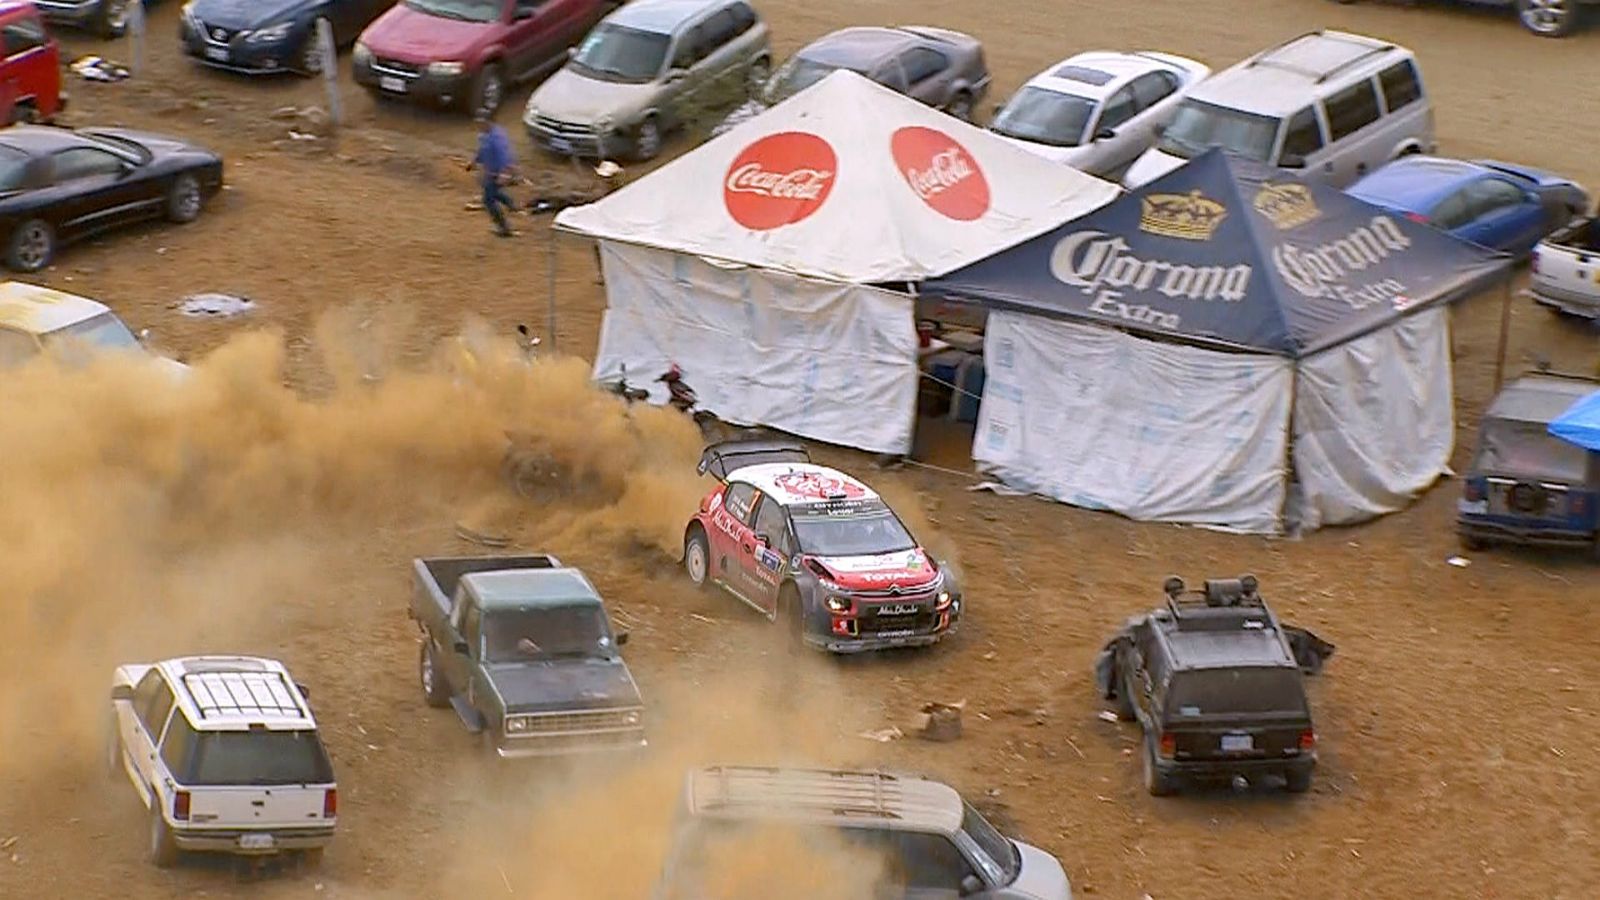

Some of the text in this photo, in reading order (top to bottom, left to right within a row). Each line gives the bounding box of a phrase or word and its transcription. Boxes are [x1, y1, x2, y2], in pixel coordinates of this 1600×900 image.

[728, 162, 833, 201] Coca-Cola
[907, 147, 973, 200] Coca-Cola
[1049, 229, 1253, 302] Corona
[1271, 215, 1412, 298] Corona
[1088, 289, 1183, 330] Extra
[1337, 278, 1408, 310] Extra
[862, 572, 914, 582] TOTAL
